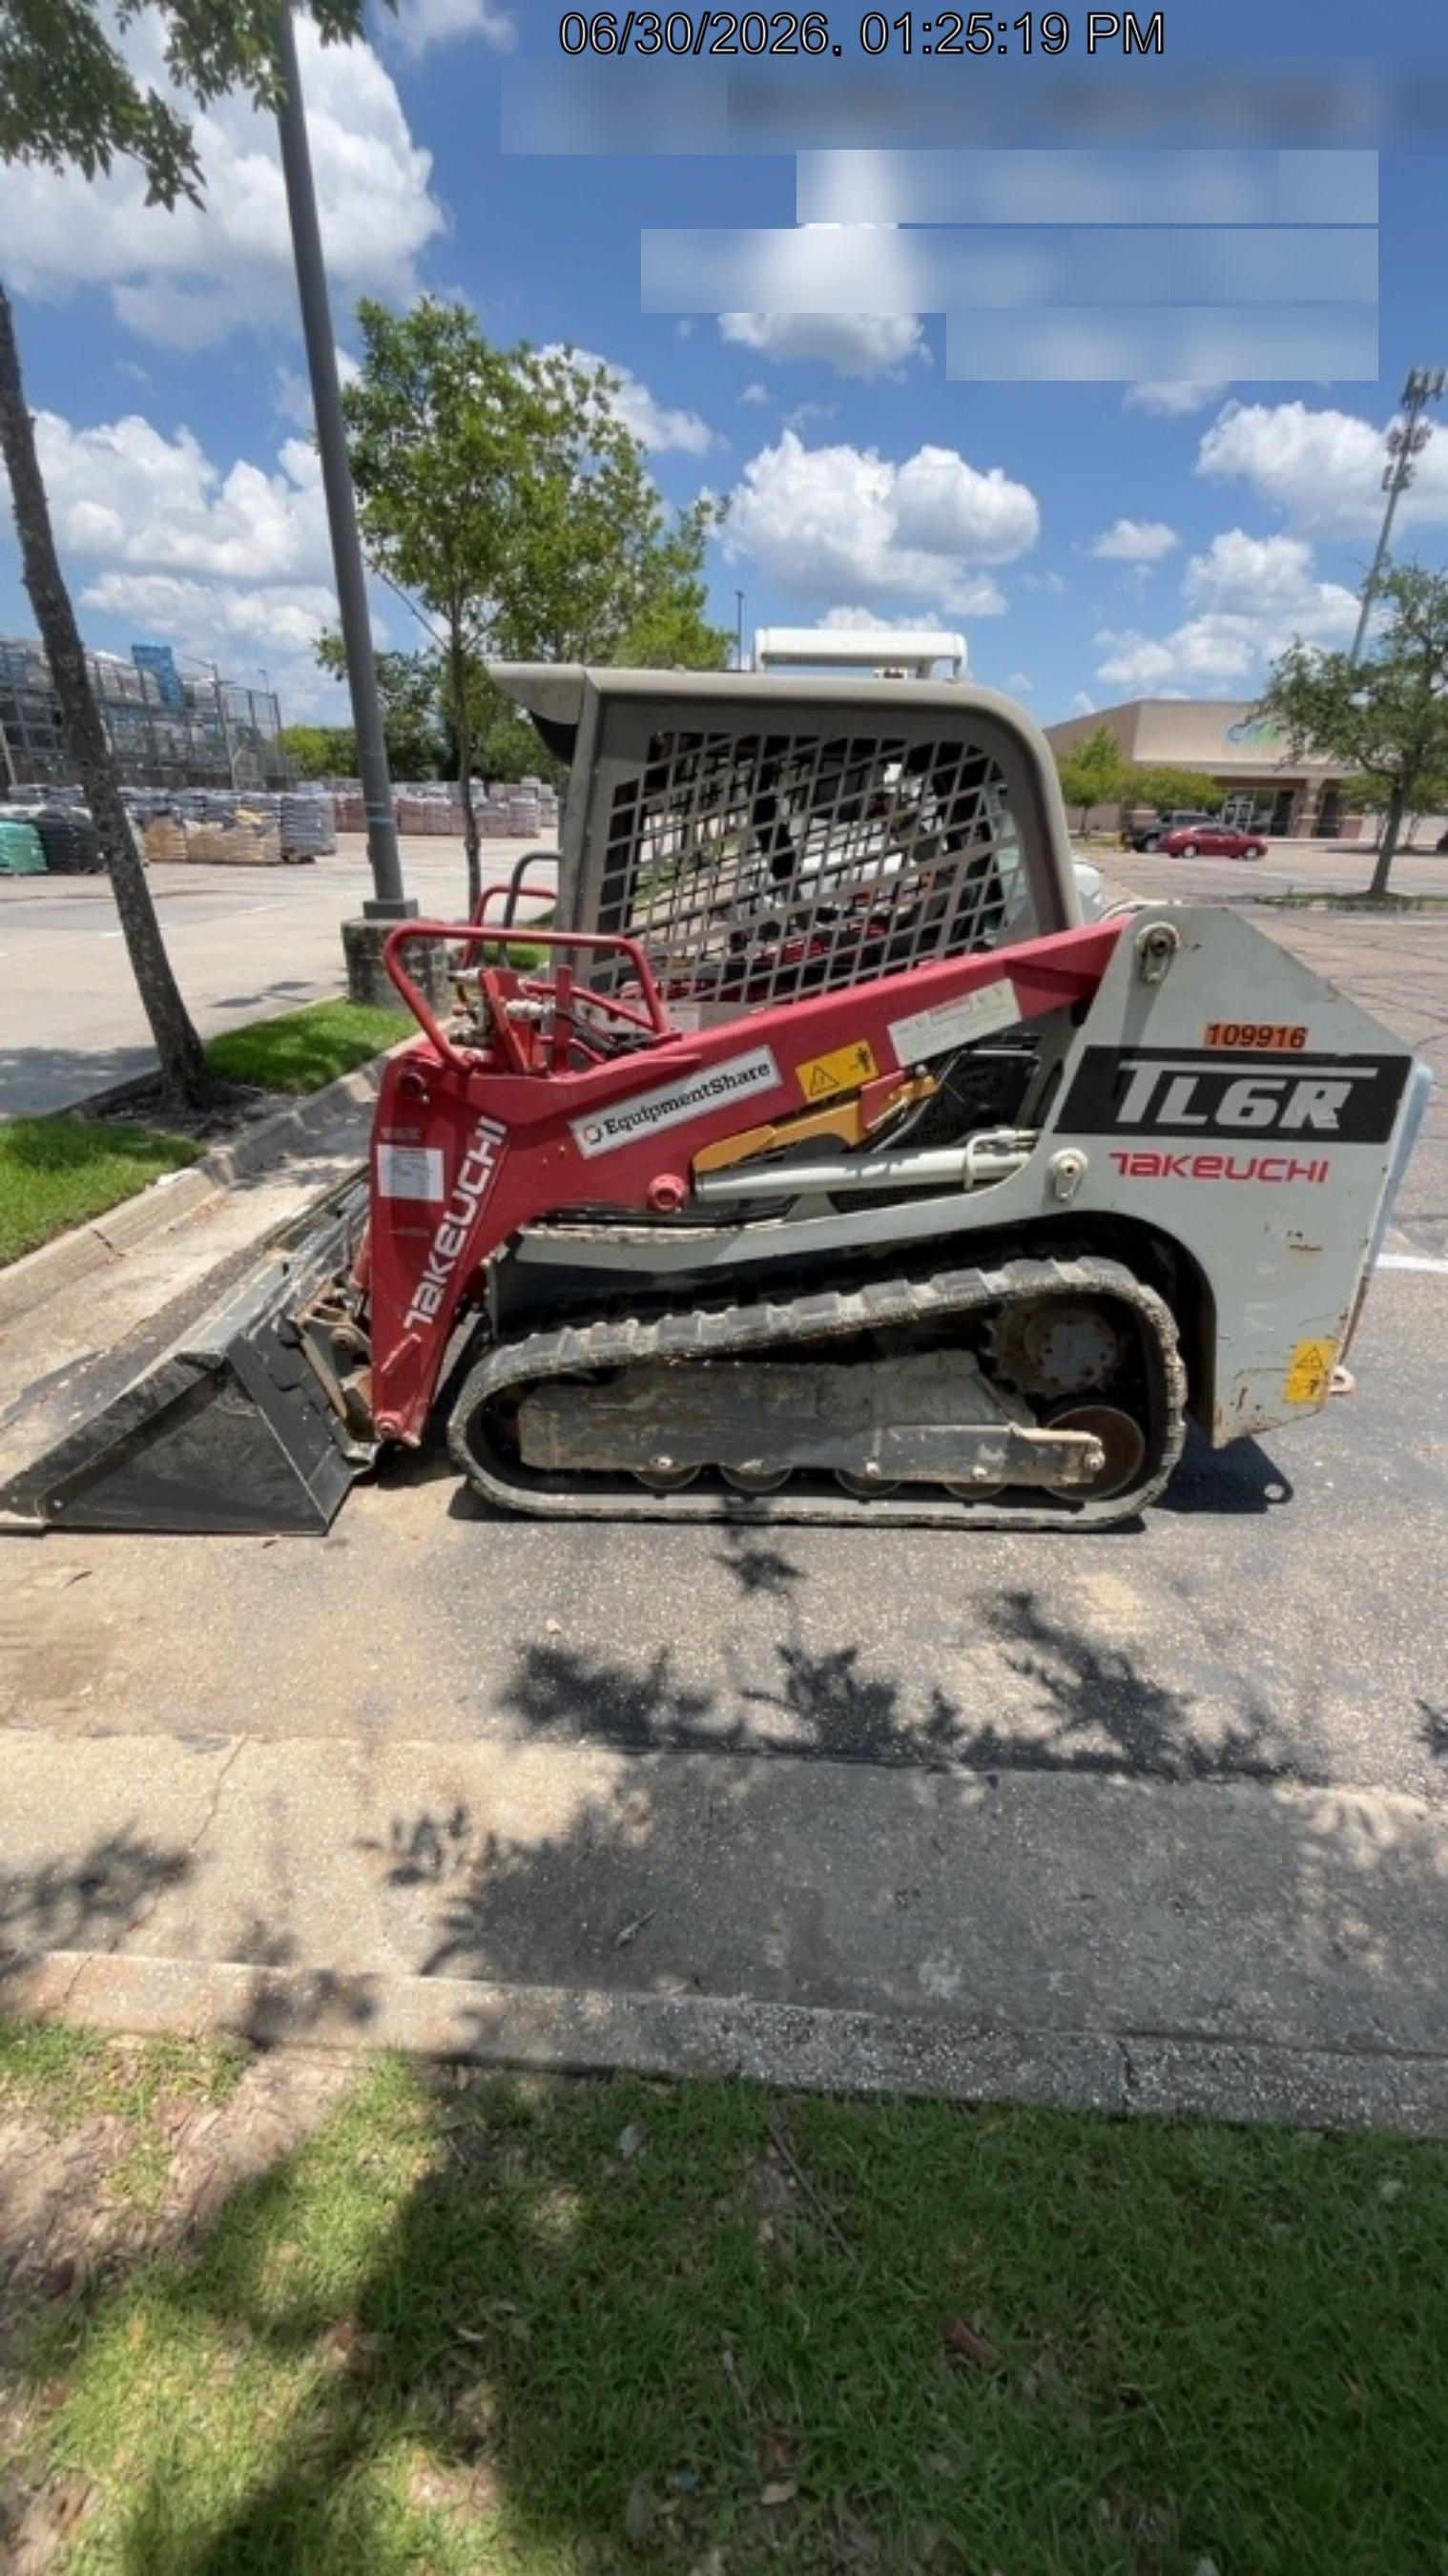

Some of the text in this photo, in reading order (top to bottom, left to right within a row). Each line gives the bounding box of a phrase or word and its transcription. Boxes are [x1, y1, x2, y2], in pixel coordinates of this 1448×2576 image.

[1208, 1024, 1307, 1049] 109916
[603, 1062, 771, 1135] EquipmentShare
[1115, 1061, 1379, 1129] TL6R
